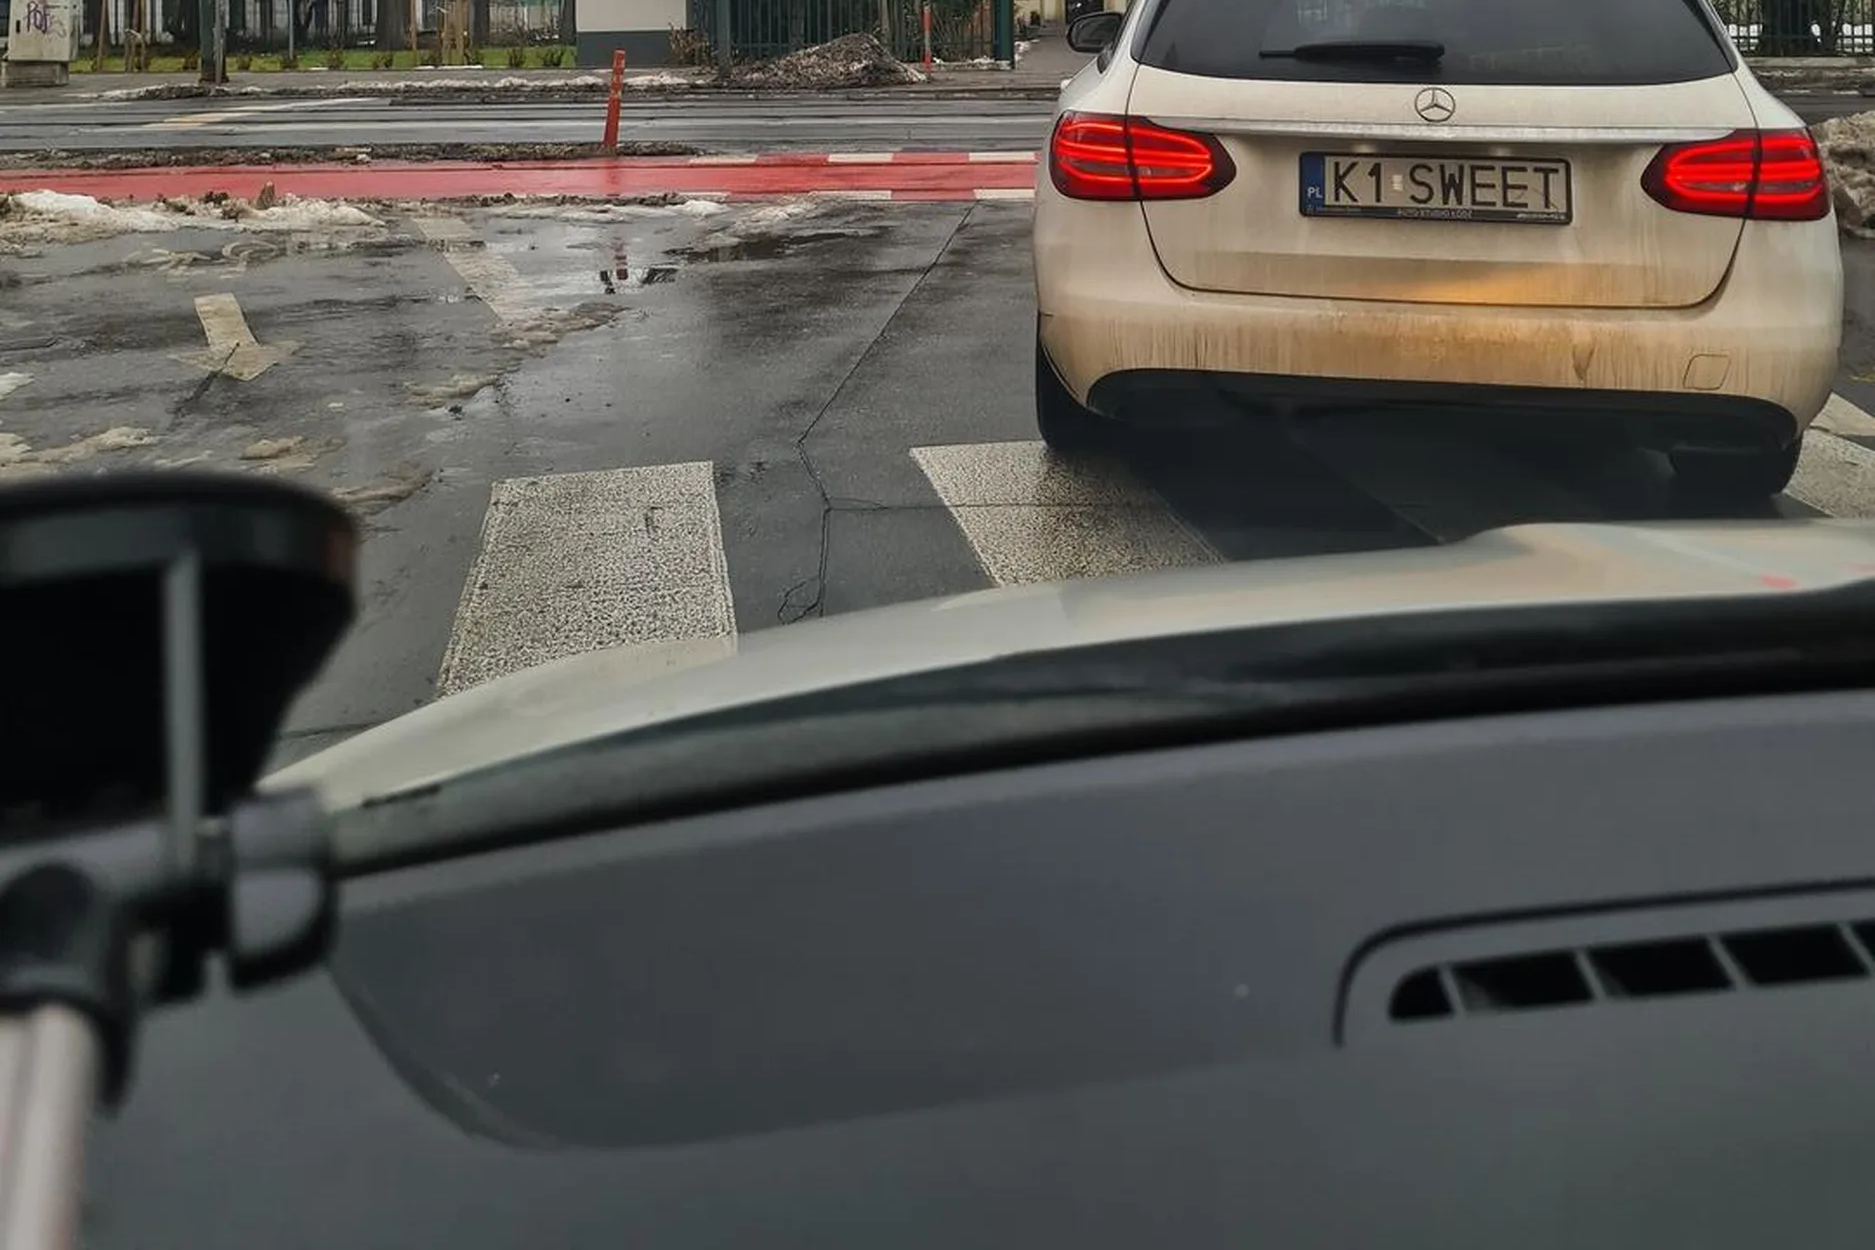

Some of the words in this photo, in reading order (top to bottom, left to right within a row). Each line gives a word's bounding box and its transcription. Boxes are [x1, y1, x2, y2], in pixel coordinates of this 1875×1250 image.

[1307, 186, 1323, 199] PL
[1333, 161, 1382, 203] K1
[1409, 163, 1560, 209] SWEET
